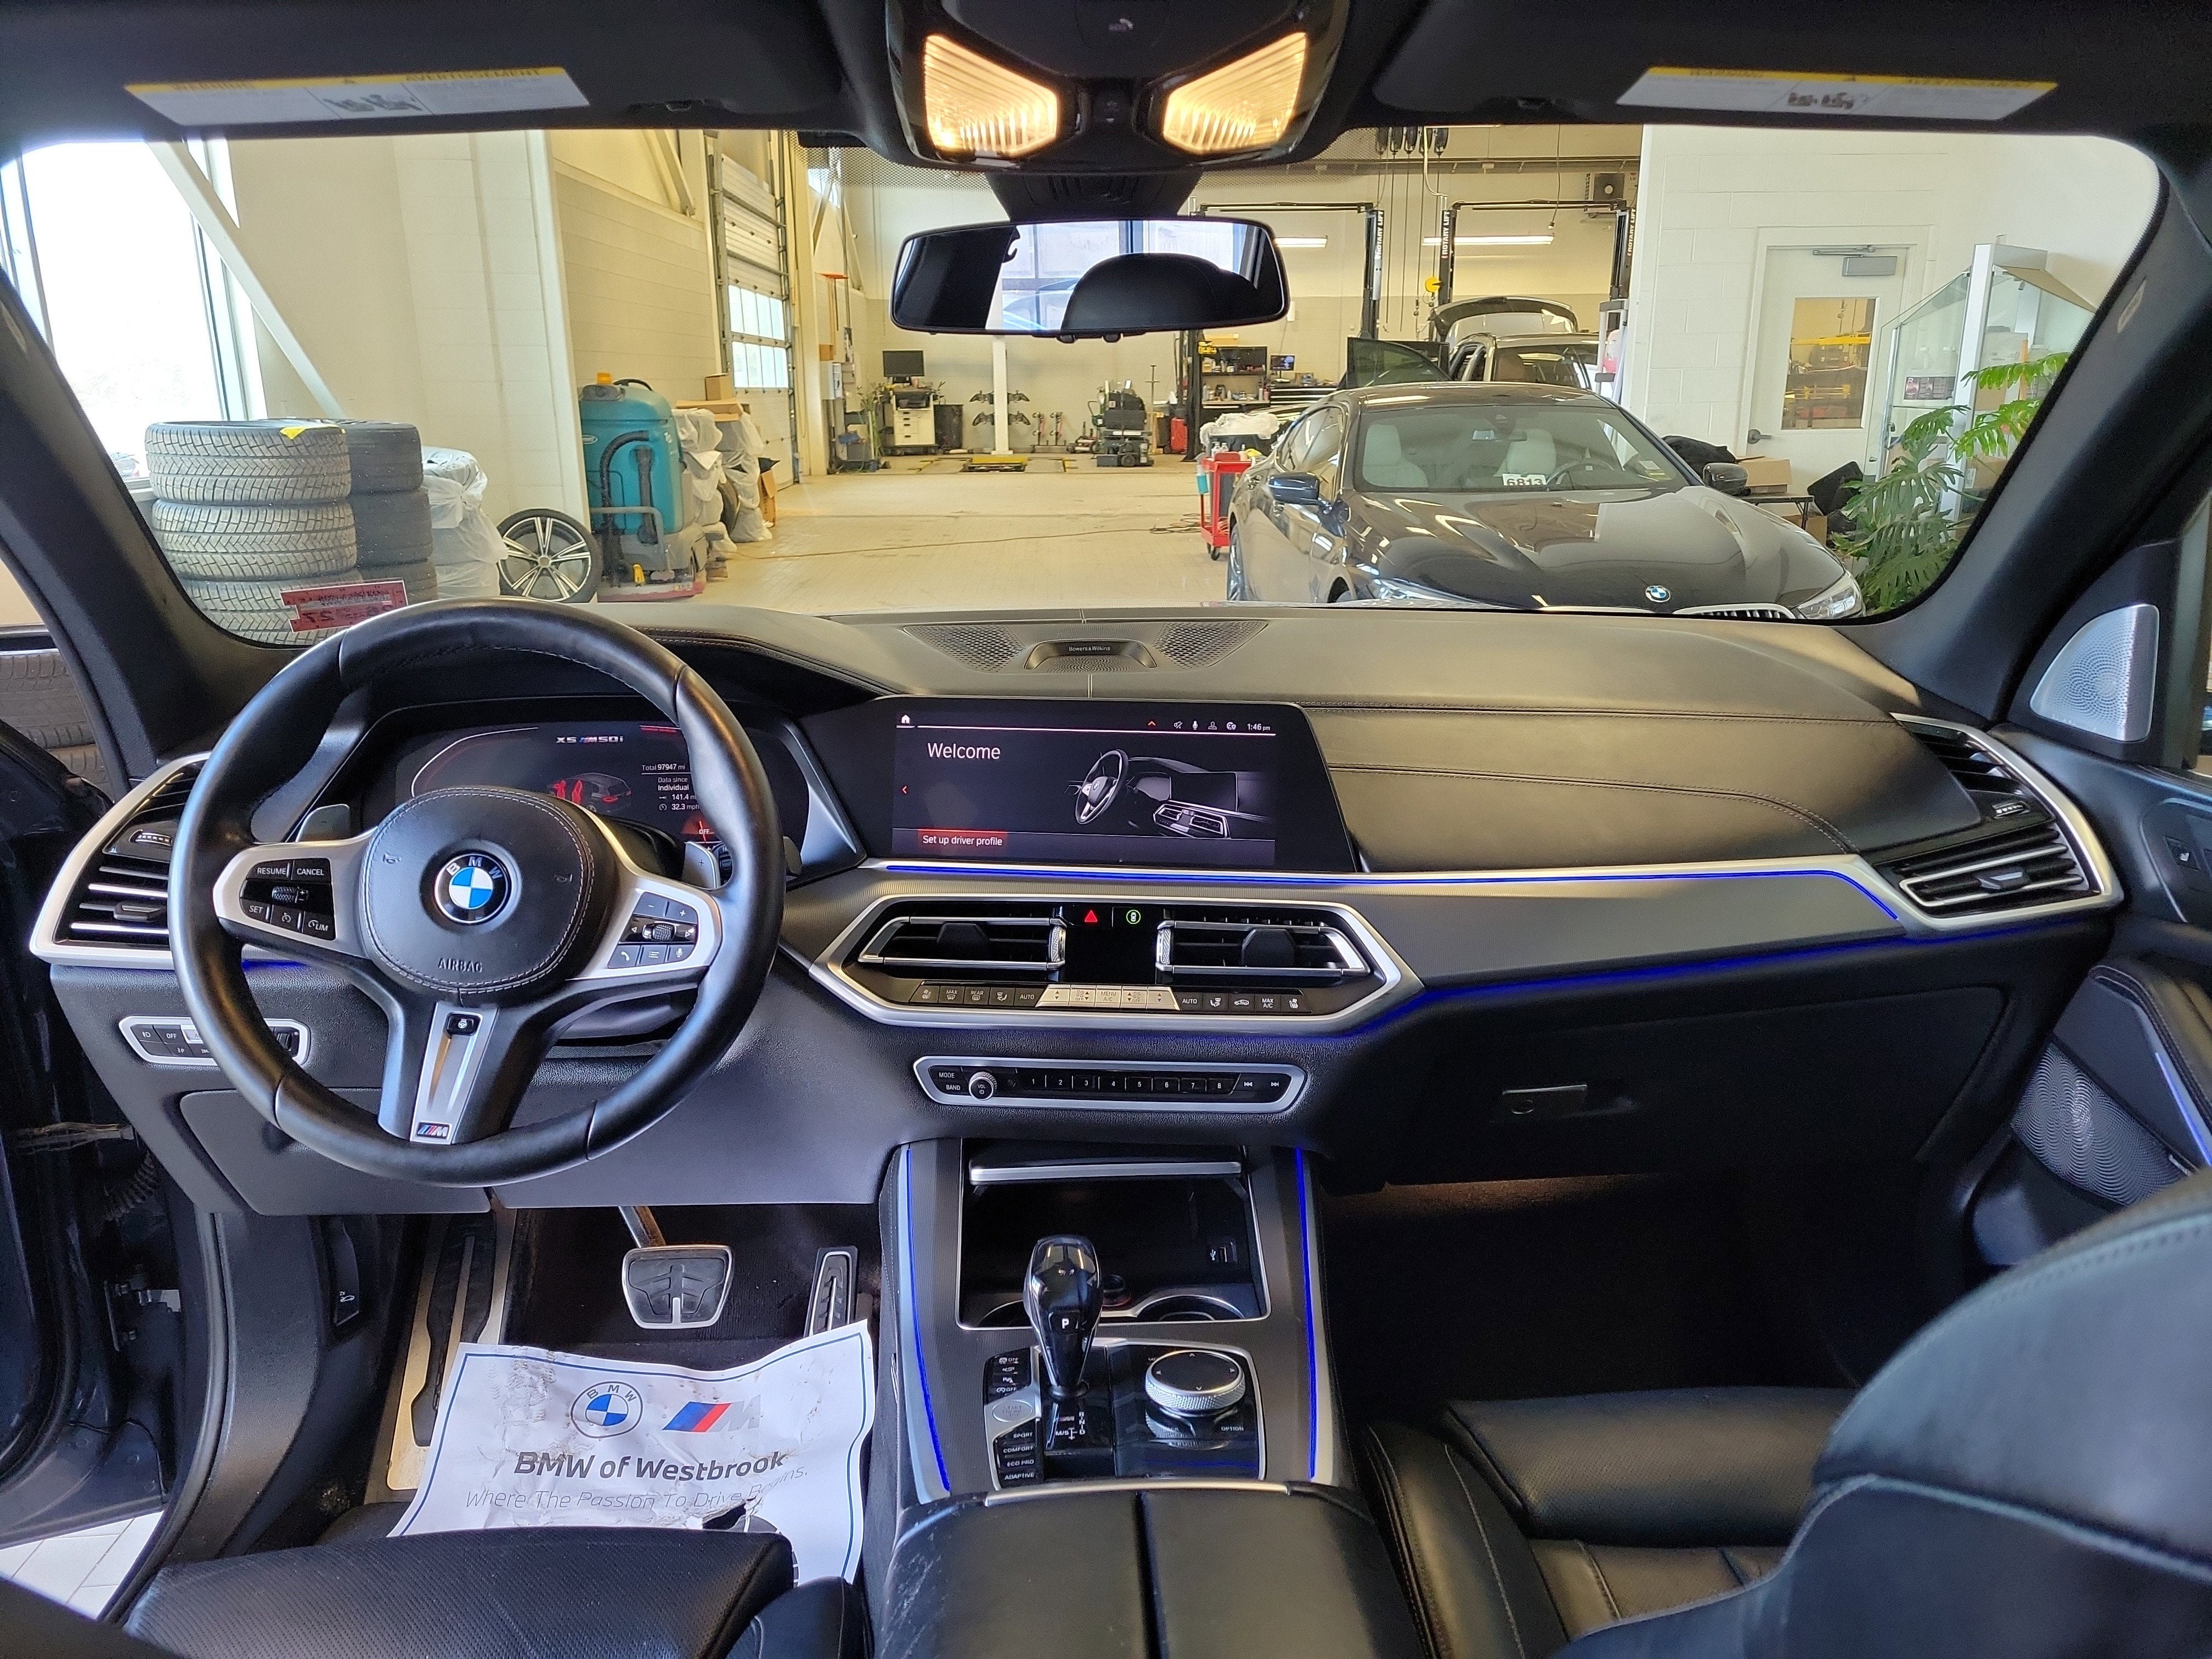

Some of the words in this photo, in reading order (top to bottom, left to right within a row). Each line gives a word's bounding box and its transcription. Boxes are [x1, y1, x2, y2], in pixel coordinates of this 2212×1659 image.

[928, 742, 1000, 759] Welcome
[923, 835, 936, 844] Set
[939, 837, 949, 845] up
[951, 836, 974, 845] driver
[977, 837, 1002, 847] profile
[446, 856, 503, 879] BMW
[249, 905, 264, 913] SET
[438, 958, 483, 973] AIRBAG
[1062, 1318, 1069, 1329] P
[587, 1384, 637, 1402] BMW
[514, 1452, 596, 1479] BMW
[600, 1456, 631, 1478] of
[636, 1451, 787, 1481] Westbrook
[1005, 1472, 1035, 1481] ADAPTIVE
[466, 1489, 526, 1508] Where
[535, 1491, 571, 1509] The
[577, 1492, 655, 1509] Passion
[664, 1493, 686, 1508] To
[693, 1491, 742, 1507] Drive
